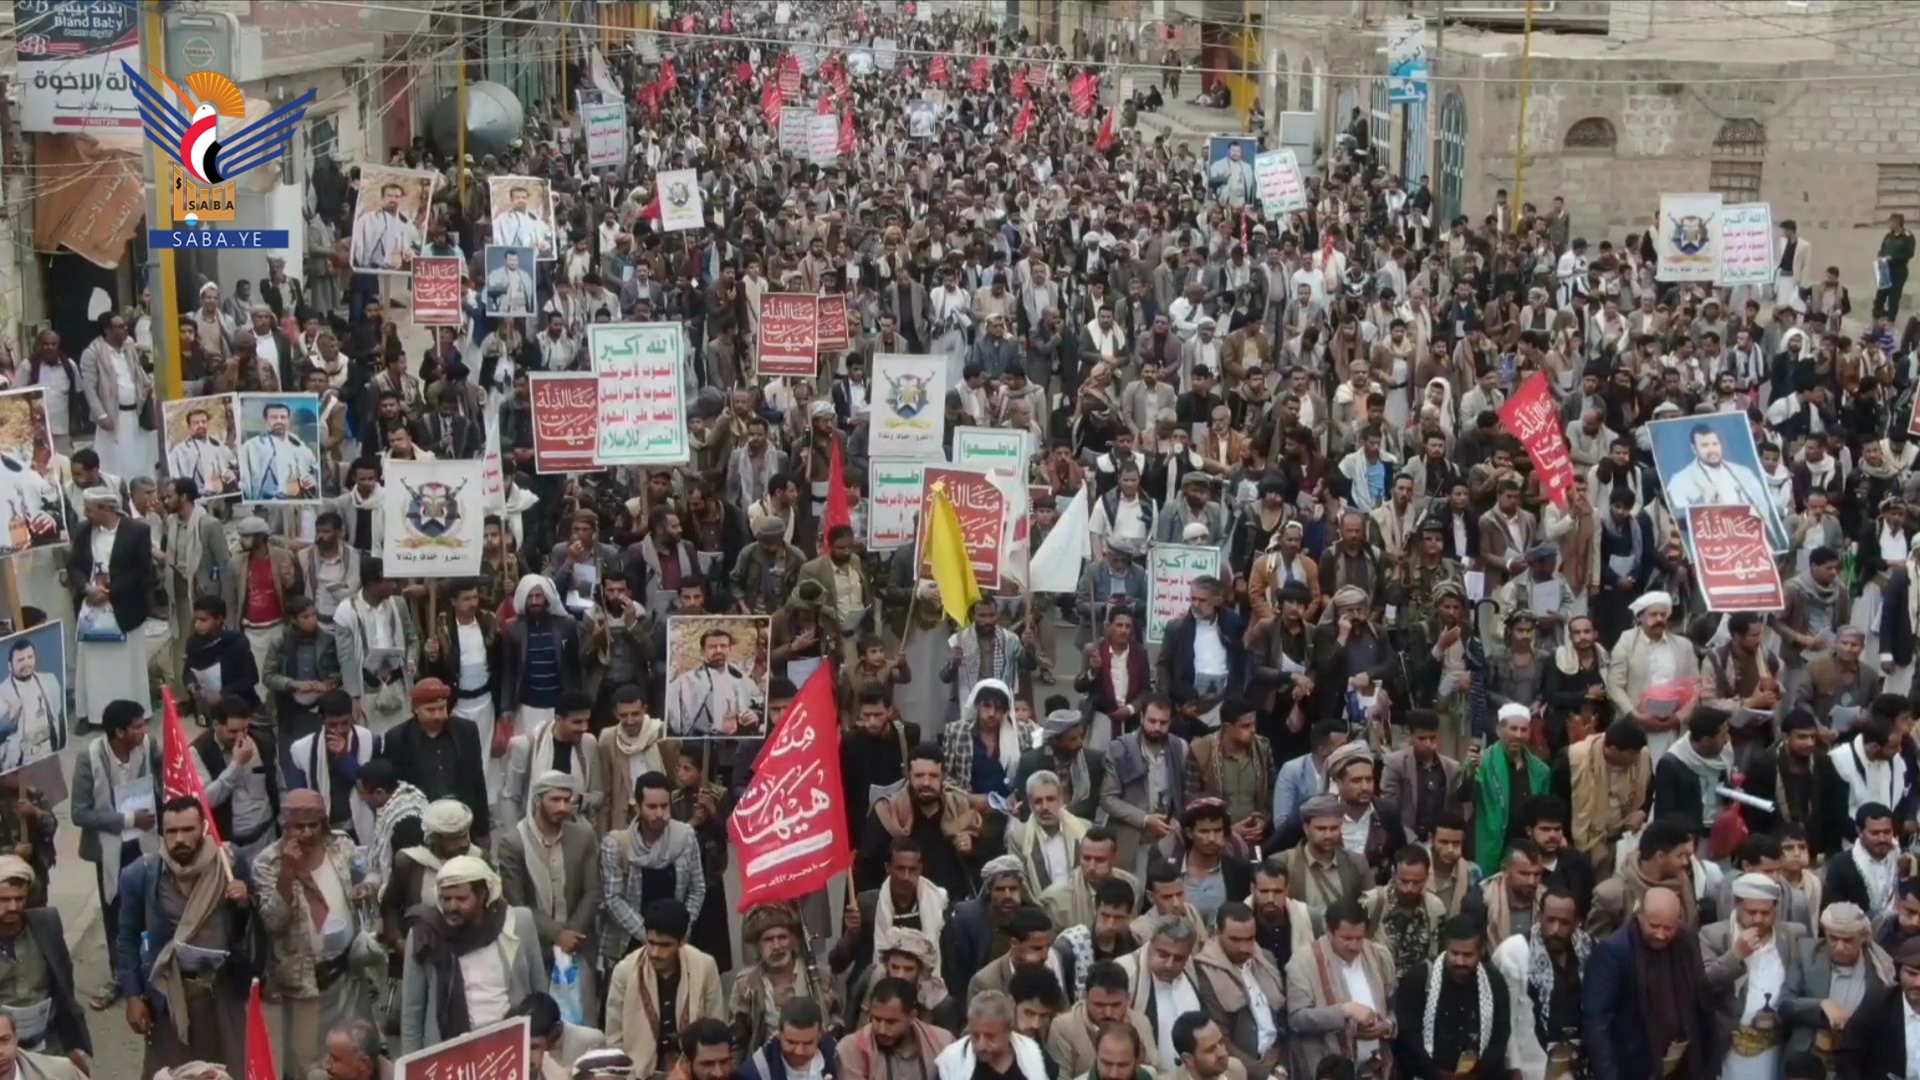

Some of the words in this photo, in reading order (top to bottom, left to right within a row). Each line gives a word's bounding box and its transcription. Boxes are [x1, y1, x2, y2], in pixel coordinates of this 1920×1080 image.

[54, 16, 89, 27] Bland
[93, 16, 123, 30] Baby
[646, 334, 674, 354] الله
[875, 467, 922, 487] اطعوا
